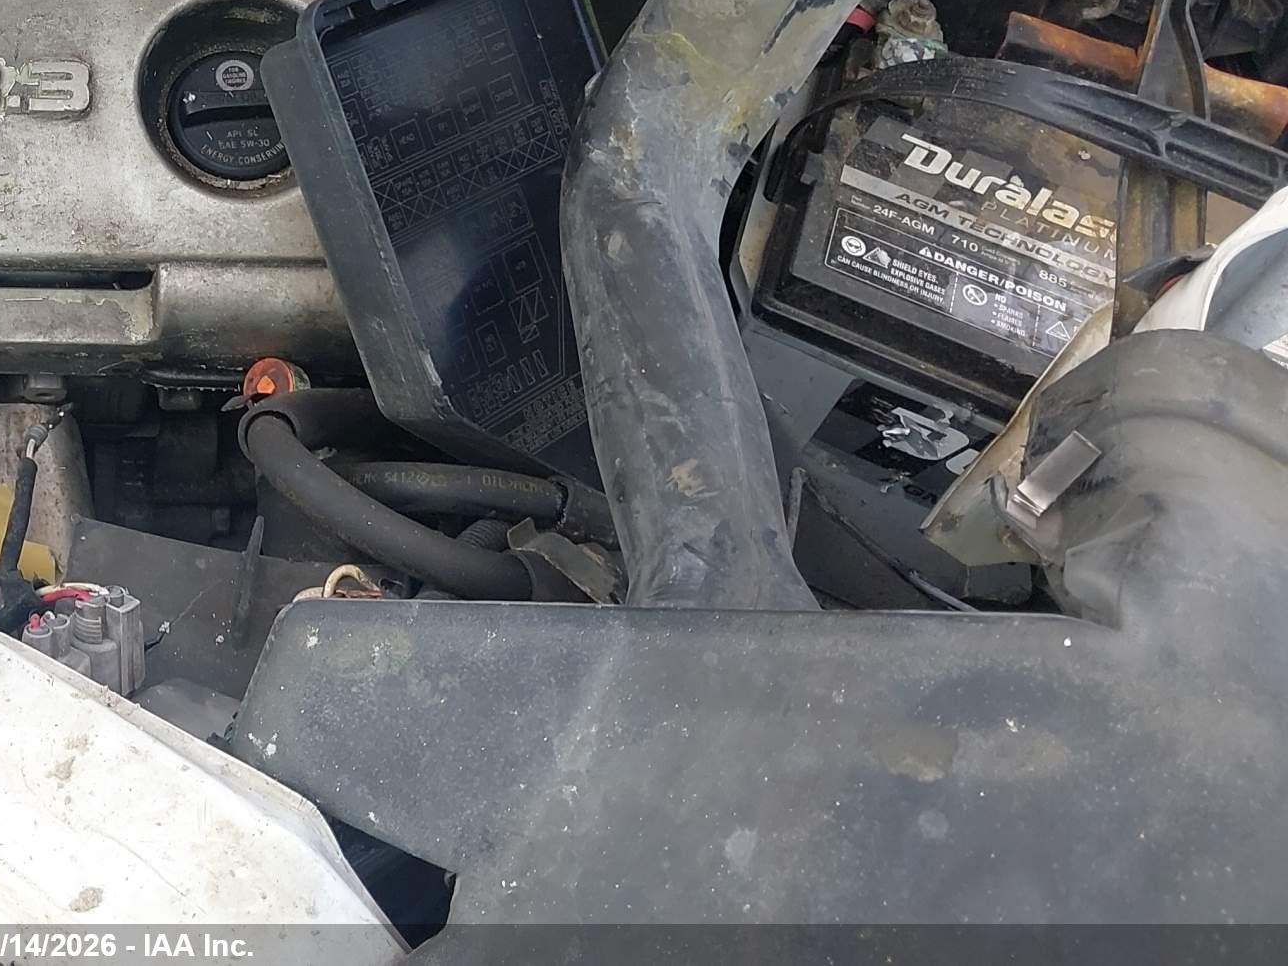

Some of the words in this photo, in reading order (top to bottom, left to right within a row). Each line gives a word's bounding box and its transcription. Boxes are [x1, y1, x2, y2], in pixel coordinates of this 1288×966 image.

[200, 143, 234, 163] ENERGY
[237, 141, 285, 165] CONSERVIN
[901, 132, 1117, 242] Duralas
[895, 193, 950, 219] AGM
[872, 204, 936, 235] 24F-AGM
[951, 233, 979, 253] 710
[837, 255, 851, 267] CAN
[851, 260, 873, 275] CAUSE
[892, 258, 918, 275] SHIELD
[890, 267, 925, 287] EXPLOSIVE
[933, 251, 1068, 312] DANGER/POISON
[1038, 269, 1068, 288] 885
[994, 293, 1007, 304] NO
